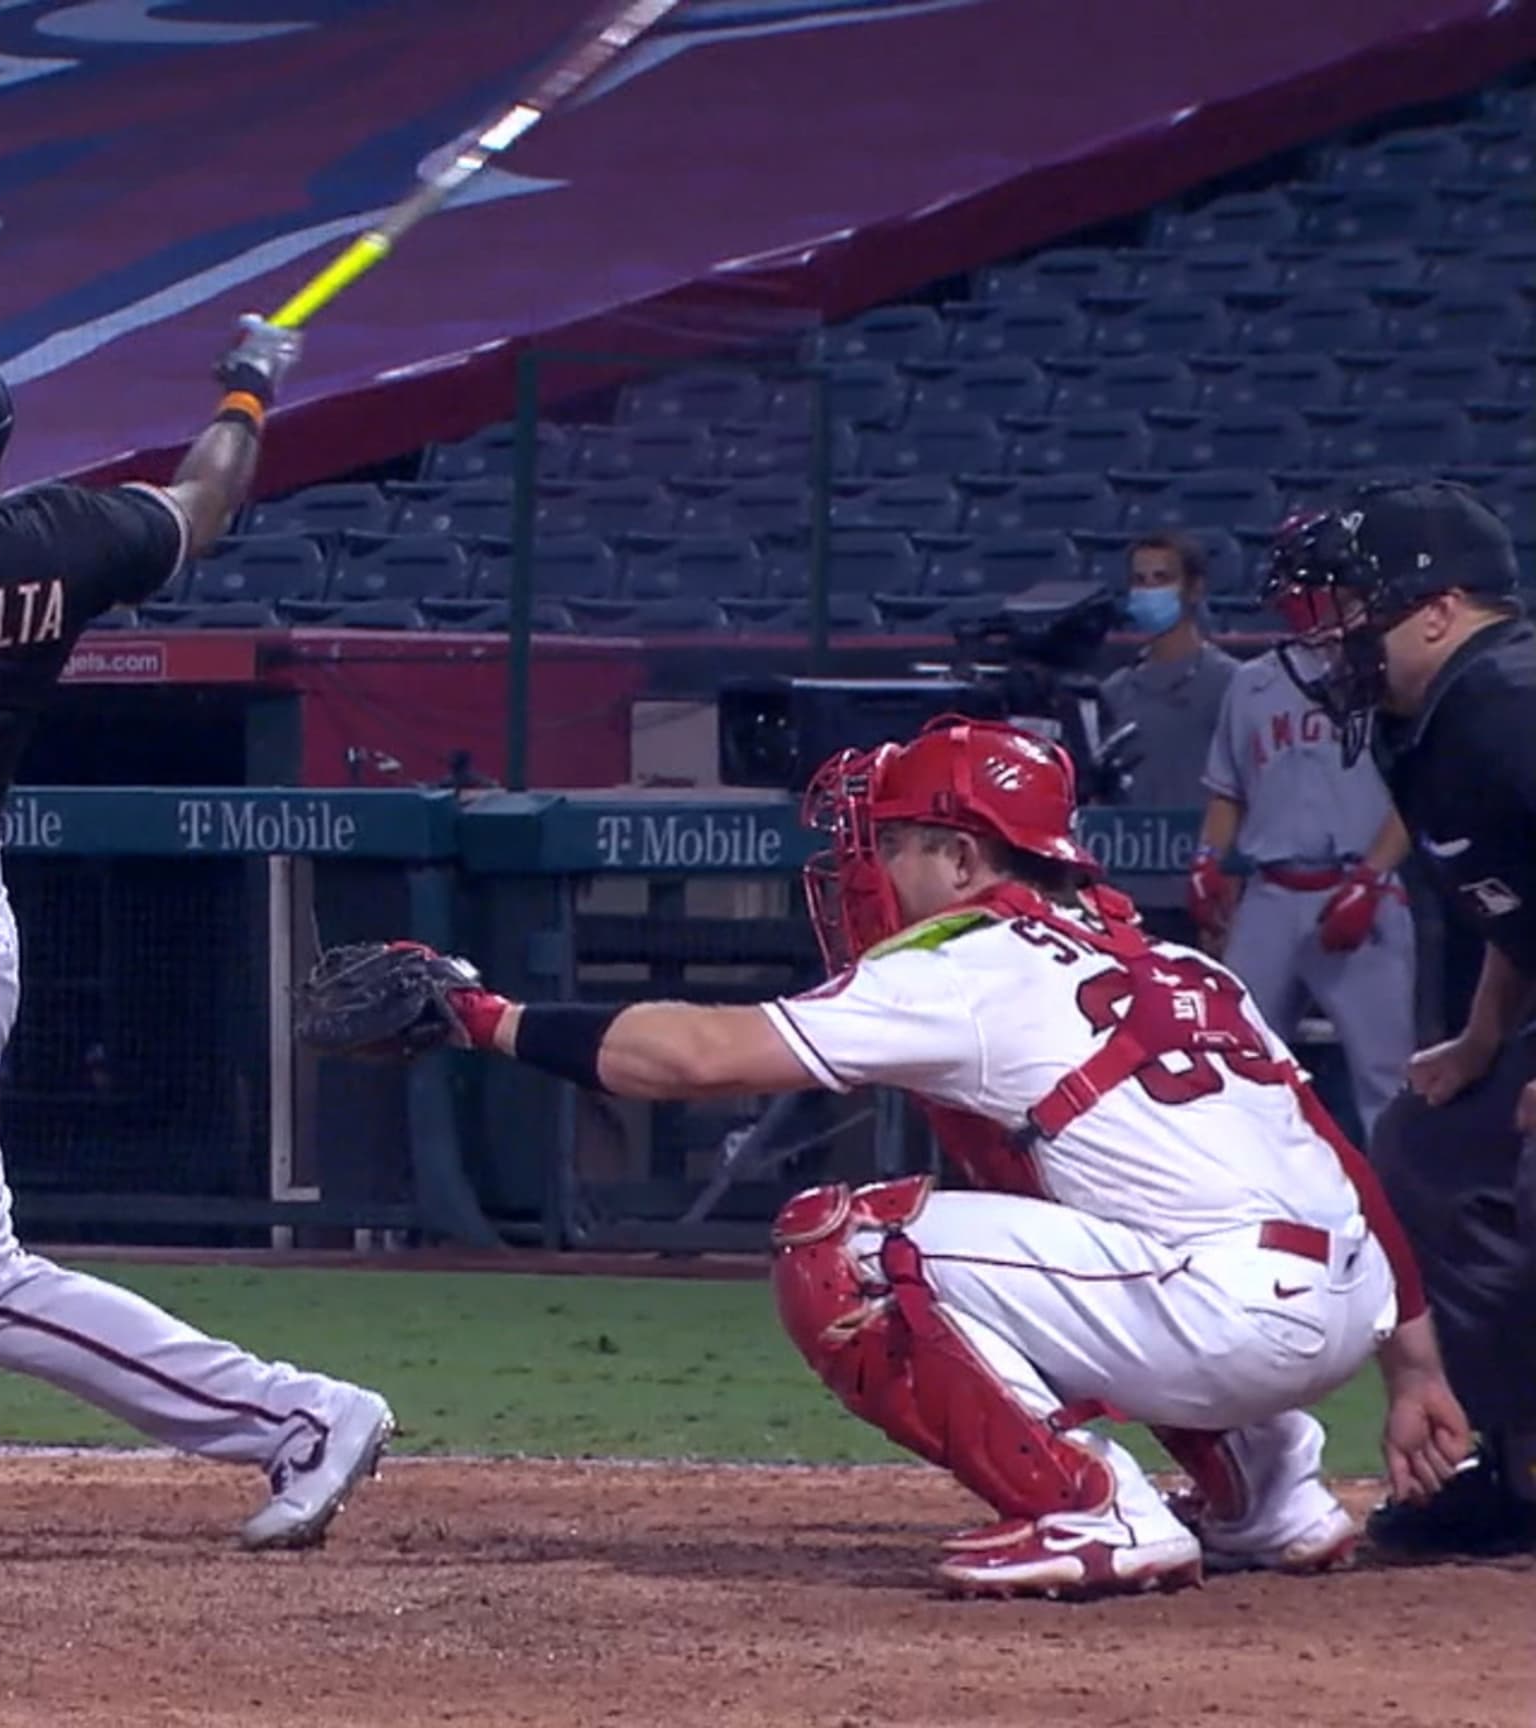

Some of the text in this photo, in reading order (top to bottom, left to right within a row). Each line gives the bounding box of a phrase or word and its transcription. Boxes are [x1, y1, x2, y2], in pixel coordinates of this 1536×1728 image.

[220, 801, 356, 850] Mobile
[639, 814, 782, 867] Mobile
[1075, 818, 1194, 870] obile
